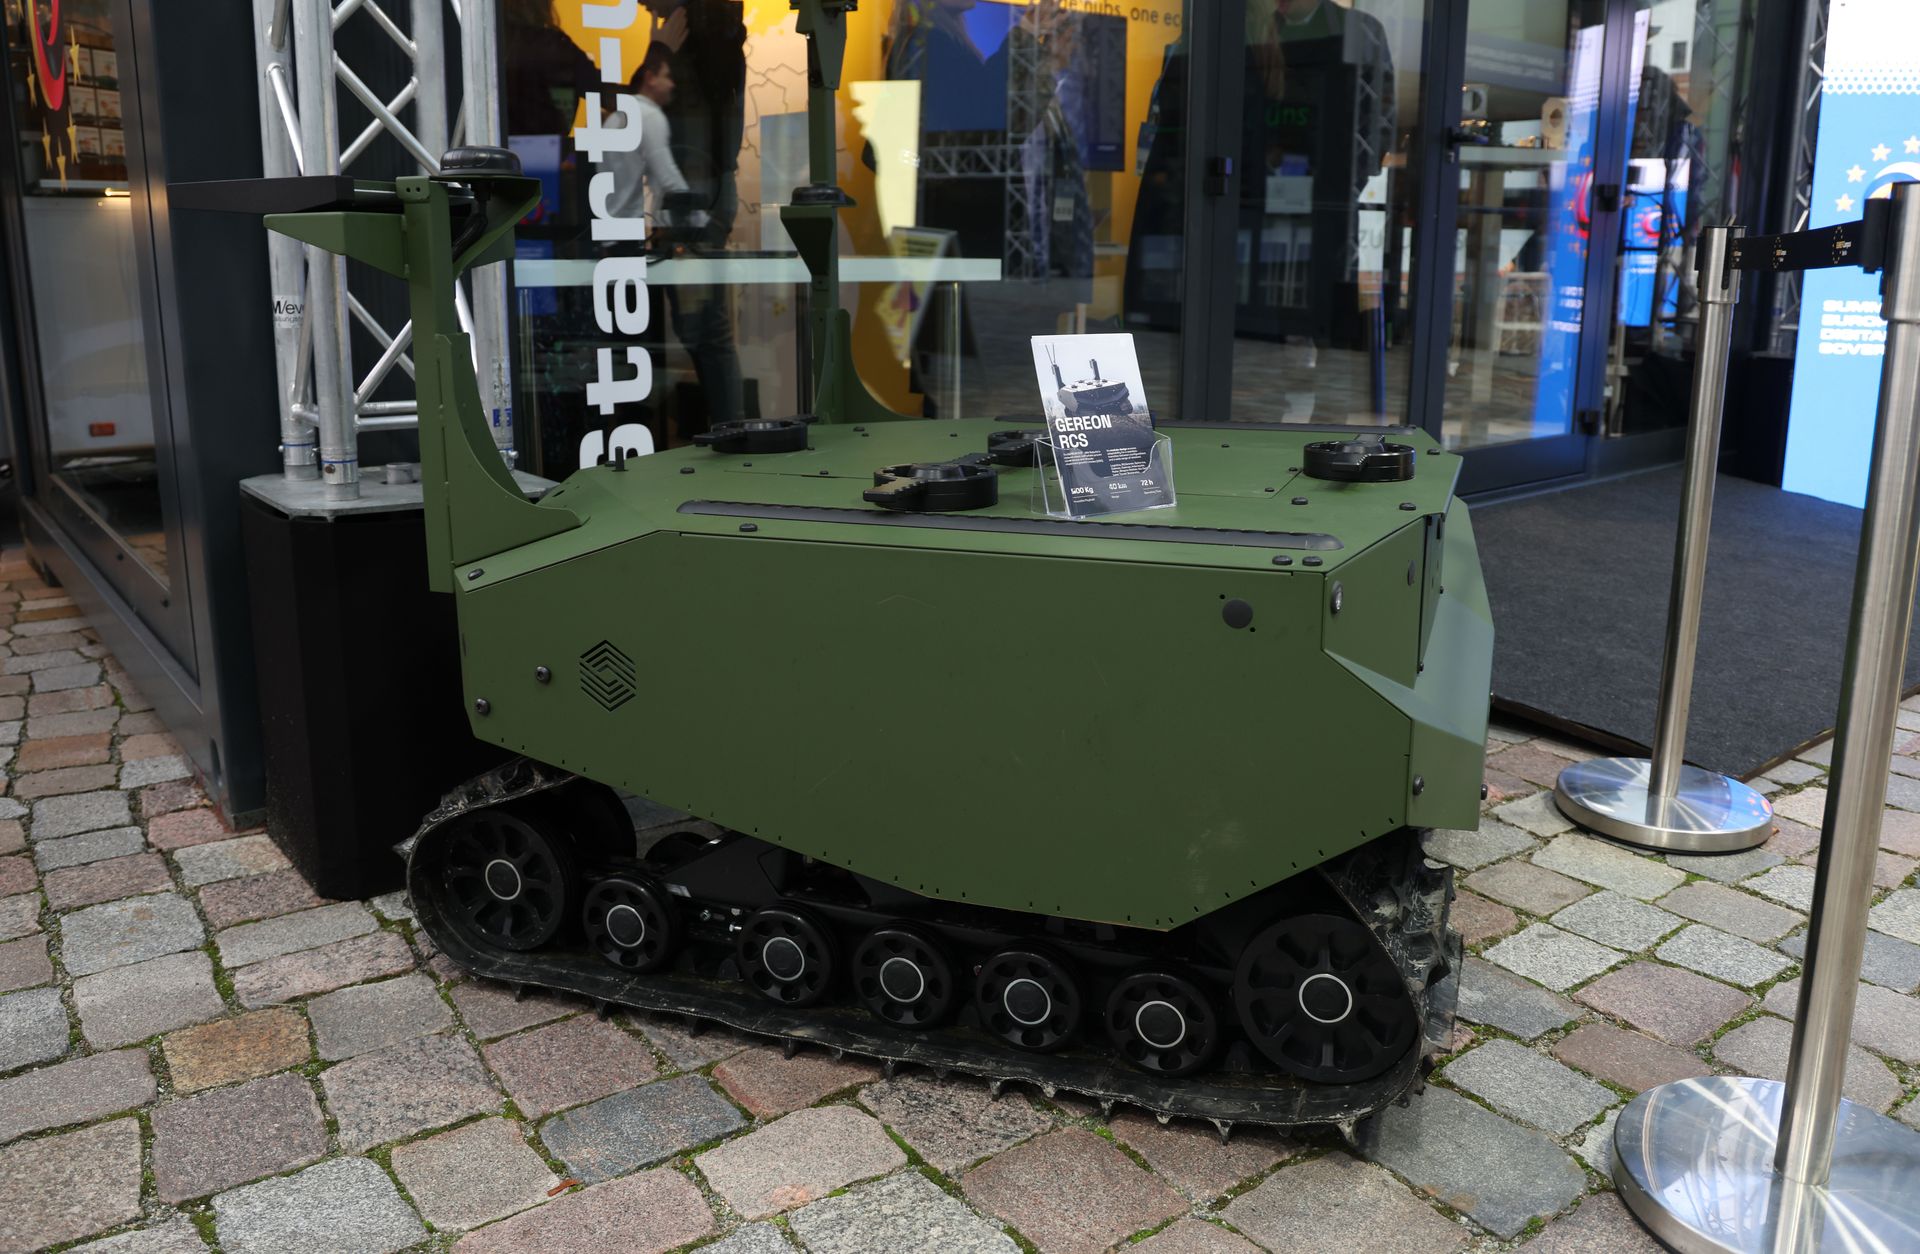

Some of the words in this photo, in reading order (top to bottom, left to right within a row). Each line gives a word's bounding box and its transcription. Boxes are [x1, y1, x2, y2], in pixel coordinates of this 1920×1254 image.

[1130, 7, 1159, 24] one
[1055, 414, 1112, 432] GEREON
[1059, 433, 1089, 449] RCS
